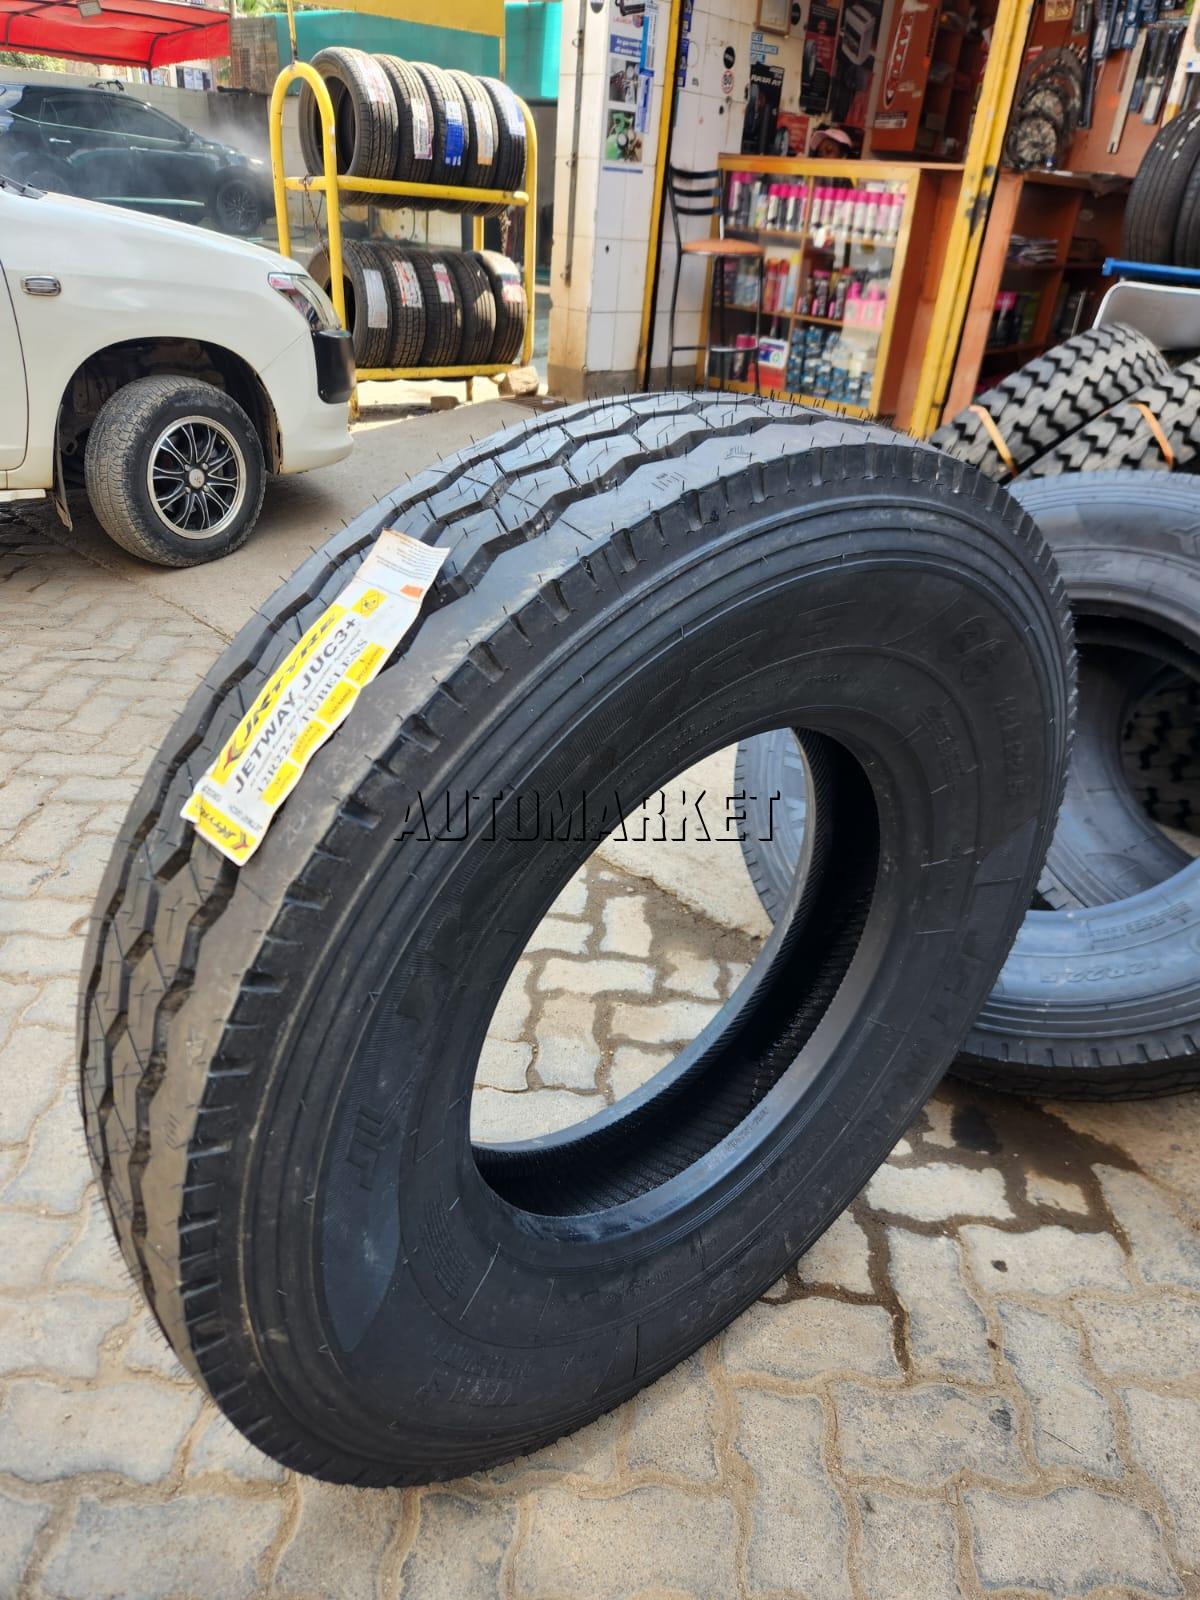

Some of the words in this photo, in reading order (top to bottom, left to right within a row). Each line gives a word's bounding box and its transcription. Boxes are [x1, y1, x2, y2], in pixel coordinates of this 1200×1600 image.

[232, 692, 298, 793] JETWAY
[302, 618, 358, 691] JUC3+
[301, 638, 370, 724] TUBELESS
